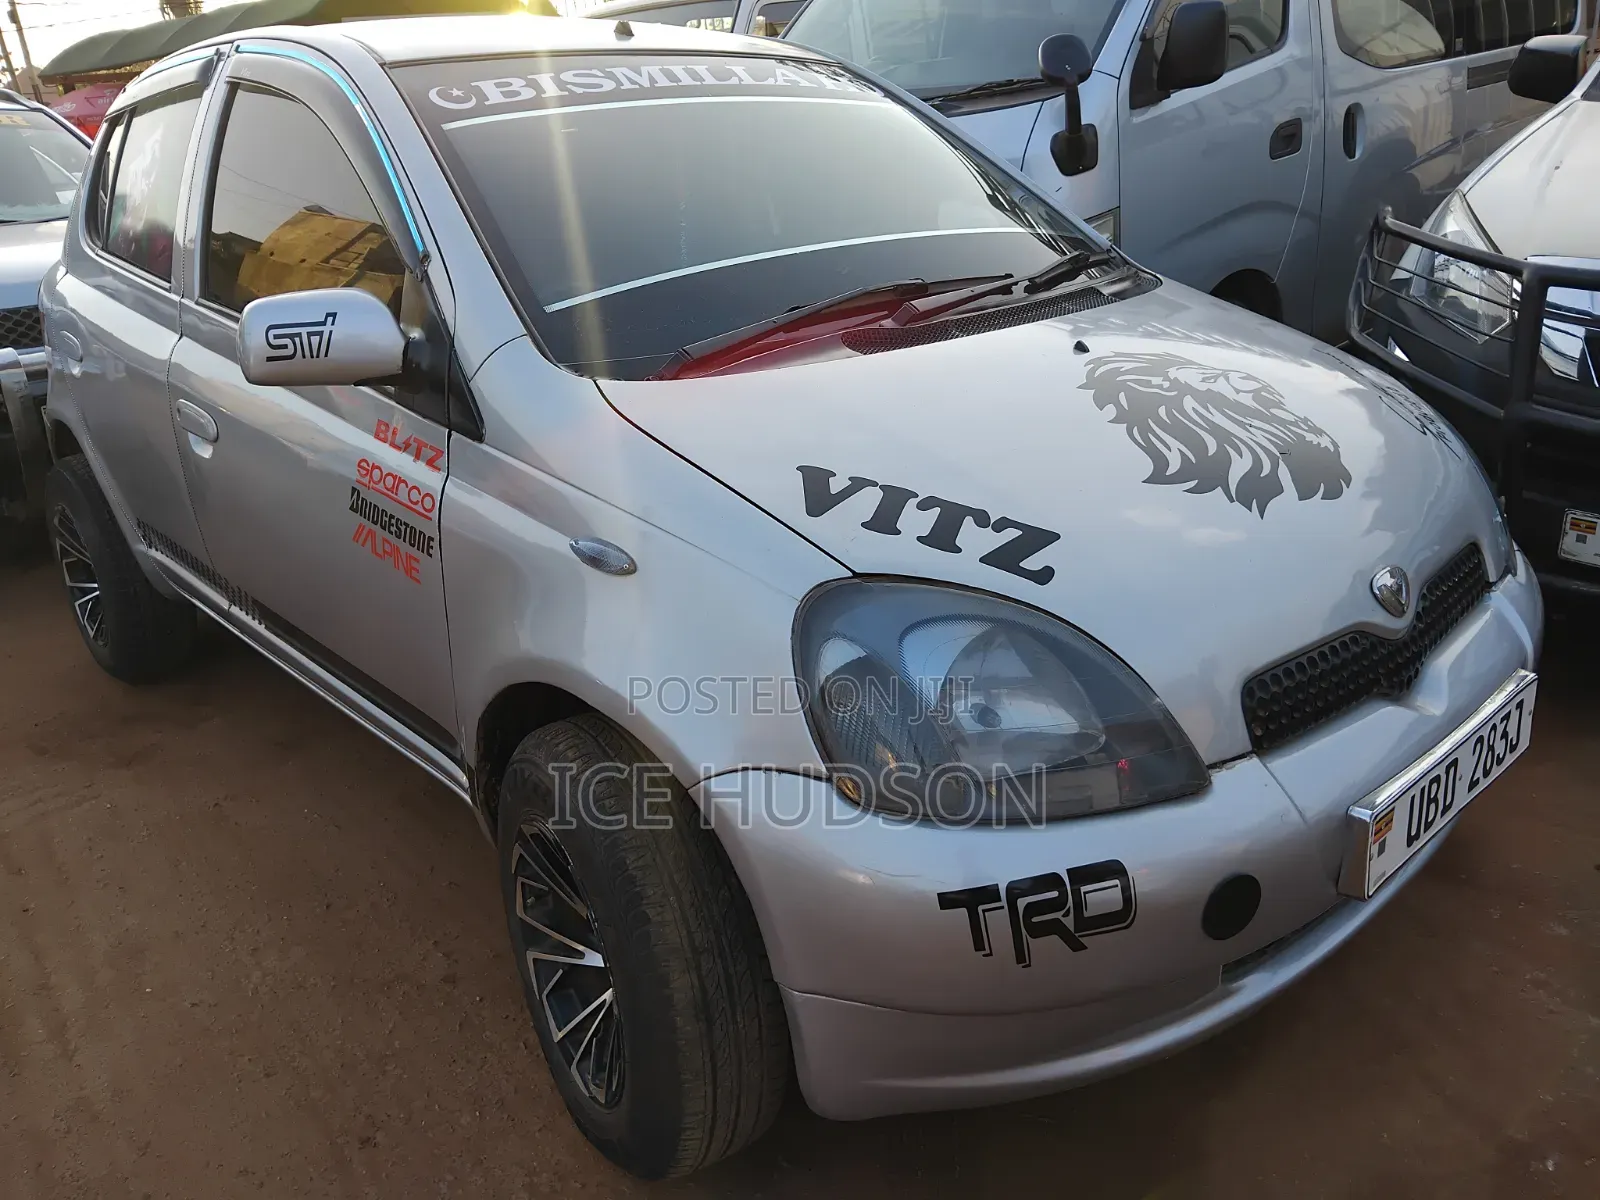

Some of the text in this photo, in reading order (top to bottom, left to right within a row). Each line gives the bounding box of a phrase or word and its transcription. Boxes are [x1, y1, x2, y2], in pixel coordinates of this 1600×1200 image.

[349, 486, 435, 558] BRIDGESTONE
[356, 458, 436, 515] sparco
[796, 465, 1061, 586] VITZ
[1406, 698, 1525, 848] UBD 283J
[937, 859, 1137, 968] TRD
